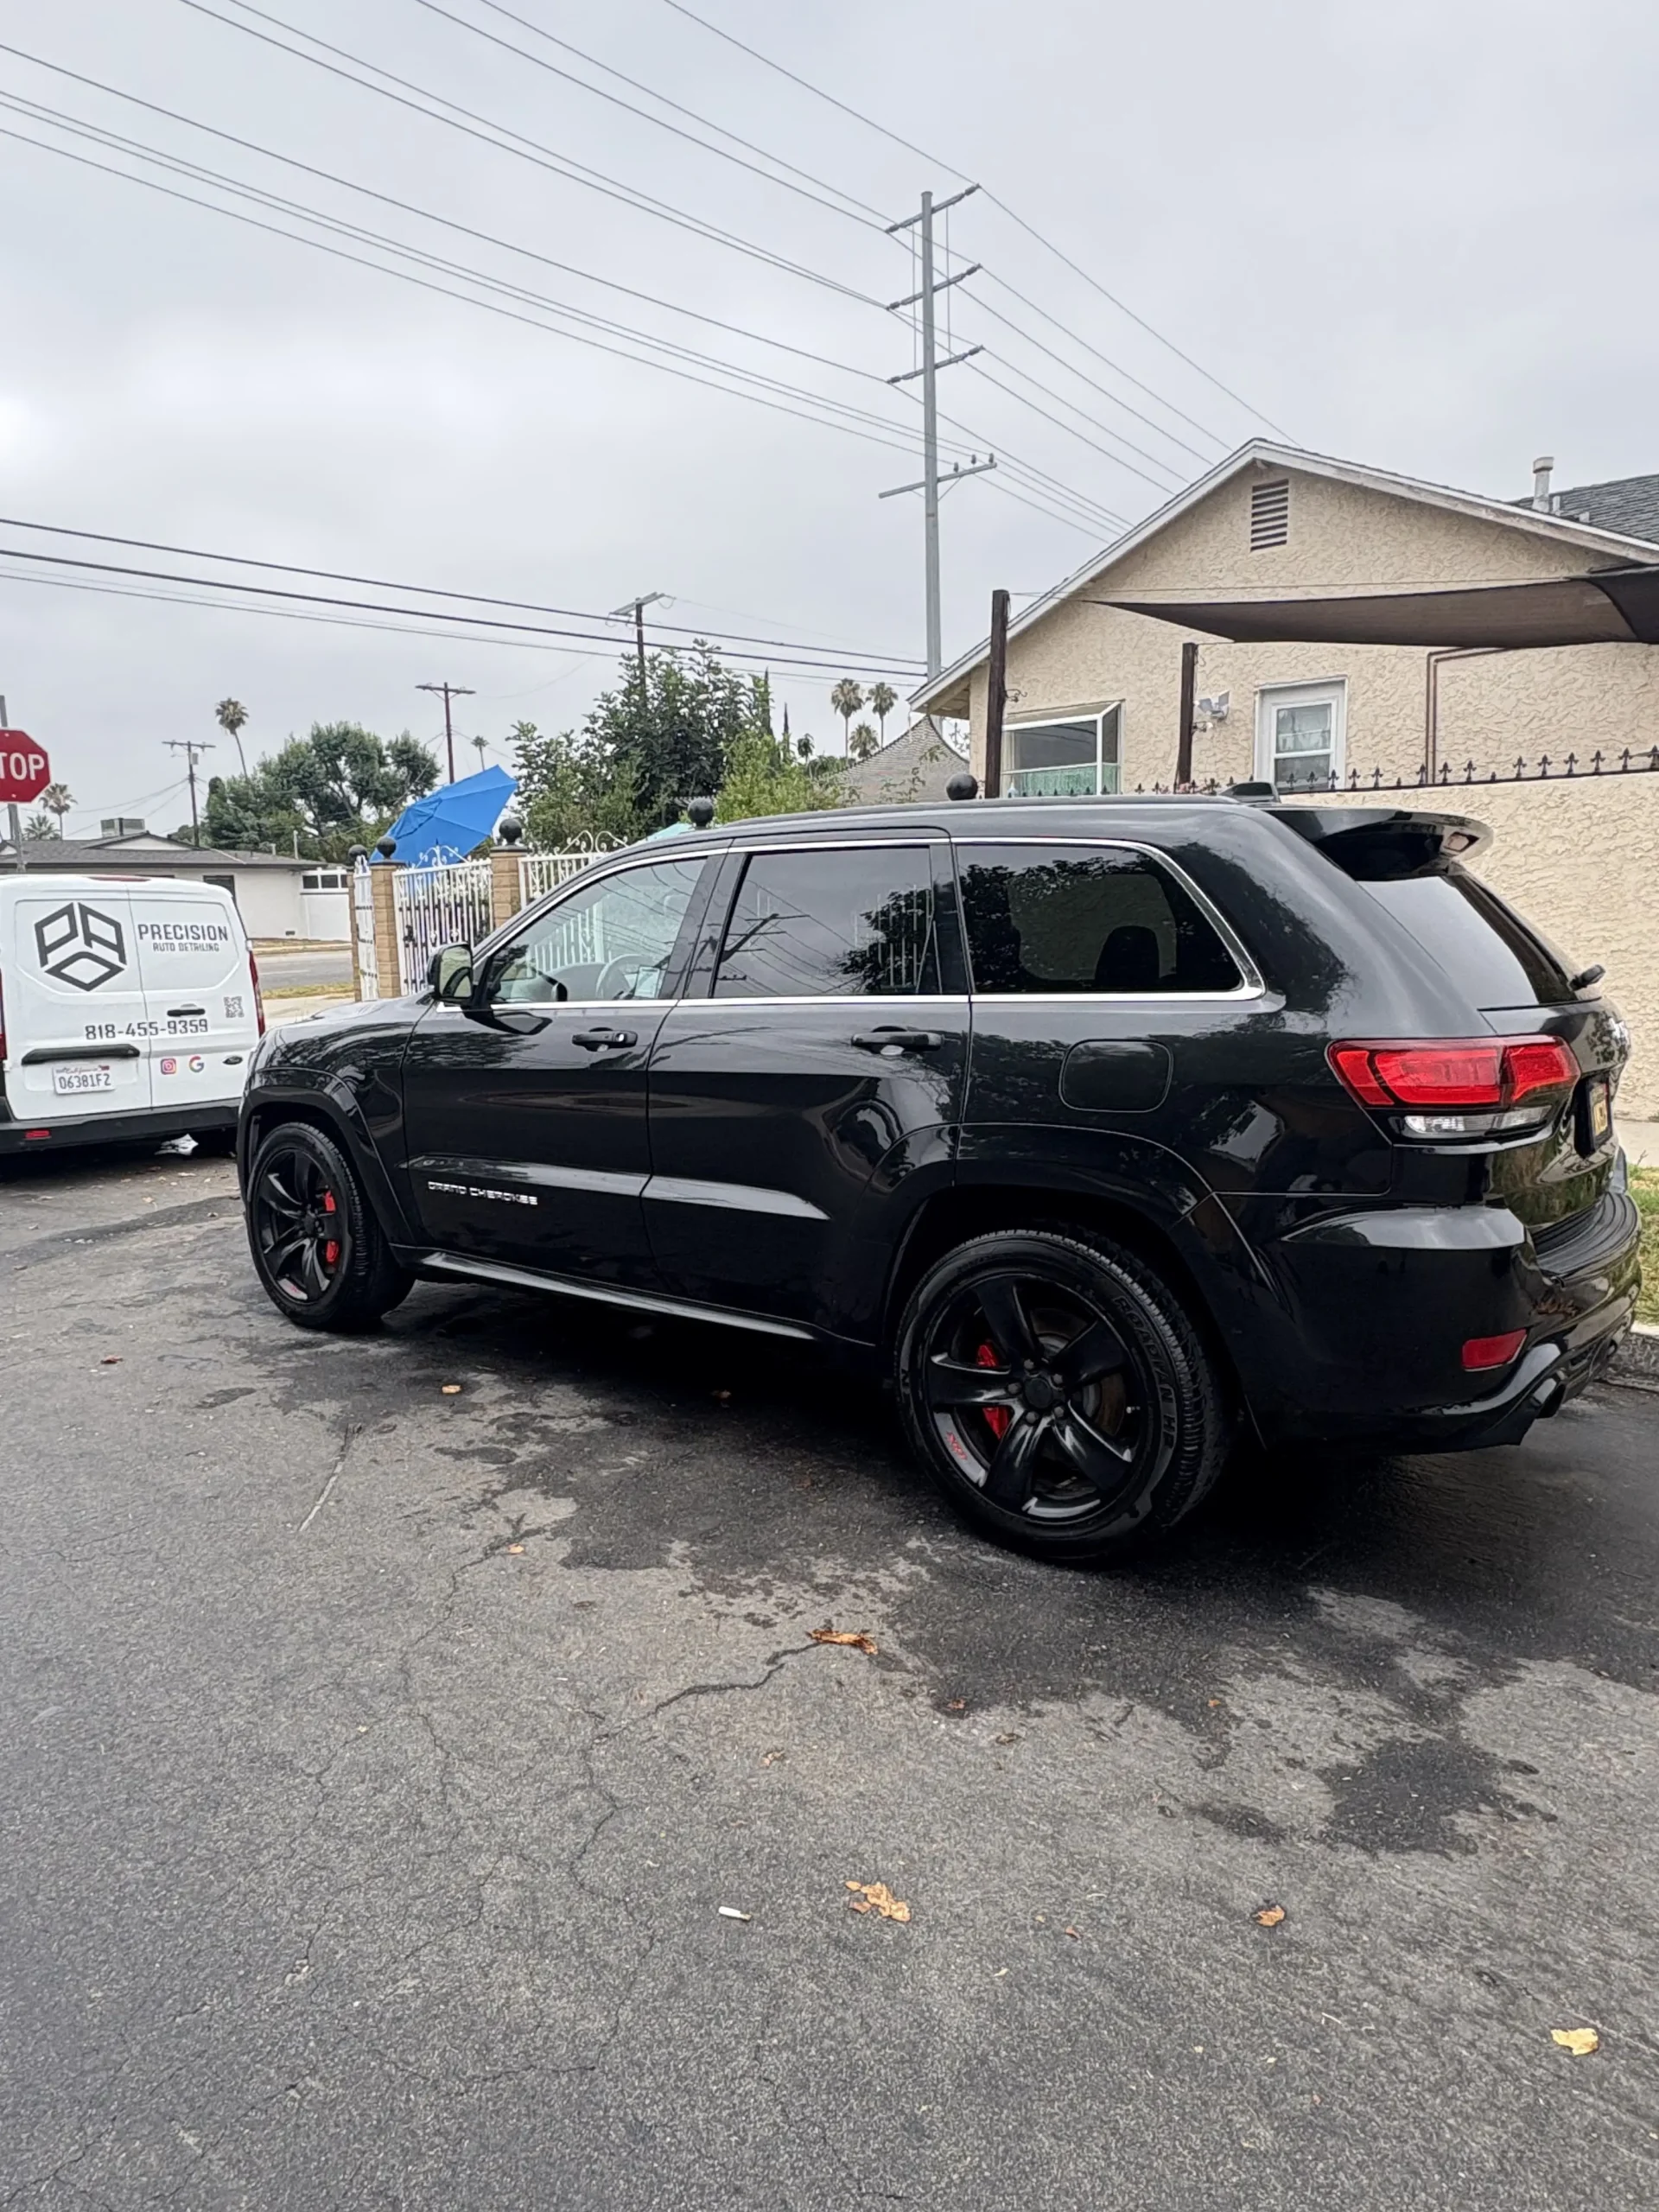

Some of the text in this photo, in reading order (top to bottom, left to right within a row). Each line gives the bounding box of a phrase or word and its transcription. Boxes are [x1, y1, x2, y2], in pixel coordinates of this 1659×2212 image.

[0, 752, 45, 781] TOP
[137, 924, 228, 941] PRECISION
[152, 942, 220, 952] AUTO DETAILING
[85, 1018, 209, 1040] 818-455-9359
[427, 1180, 538, 1205] GRAND CHEROKEE
